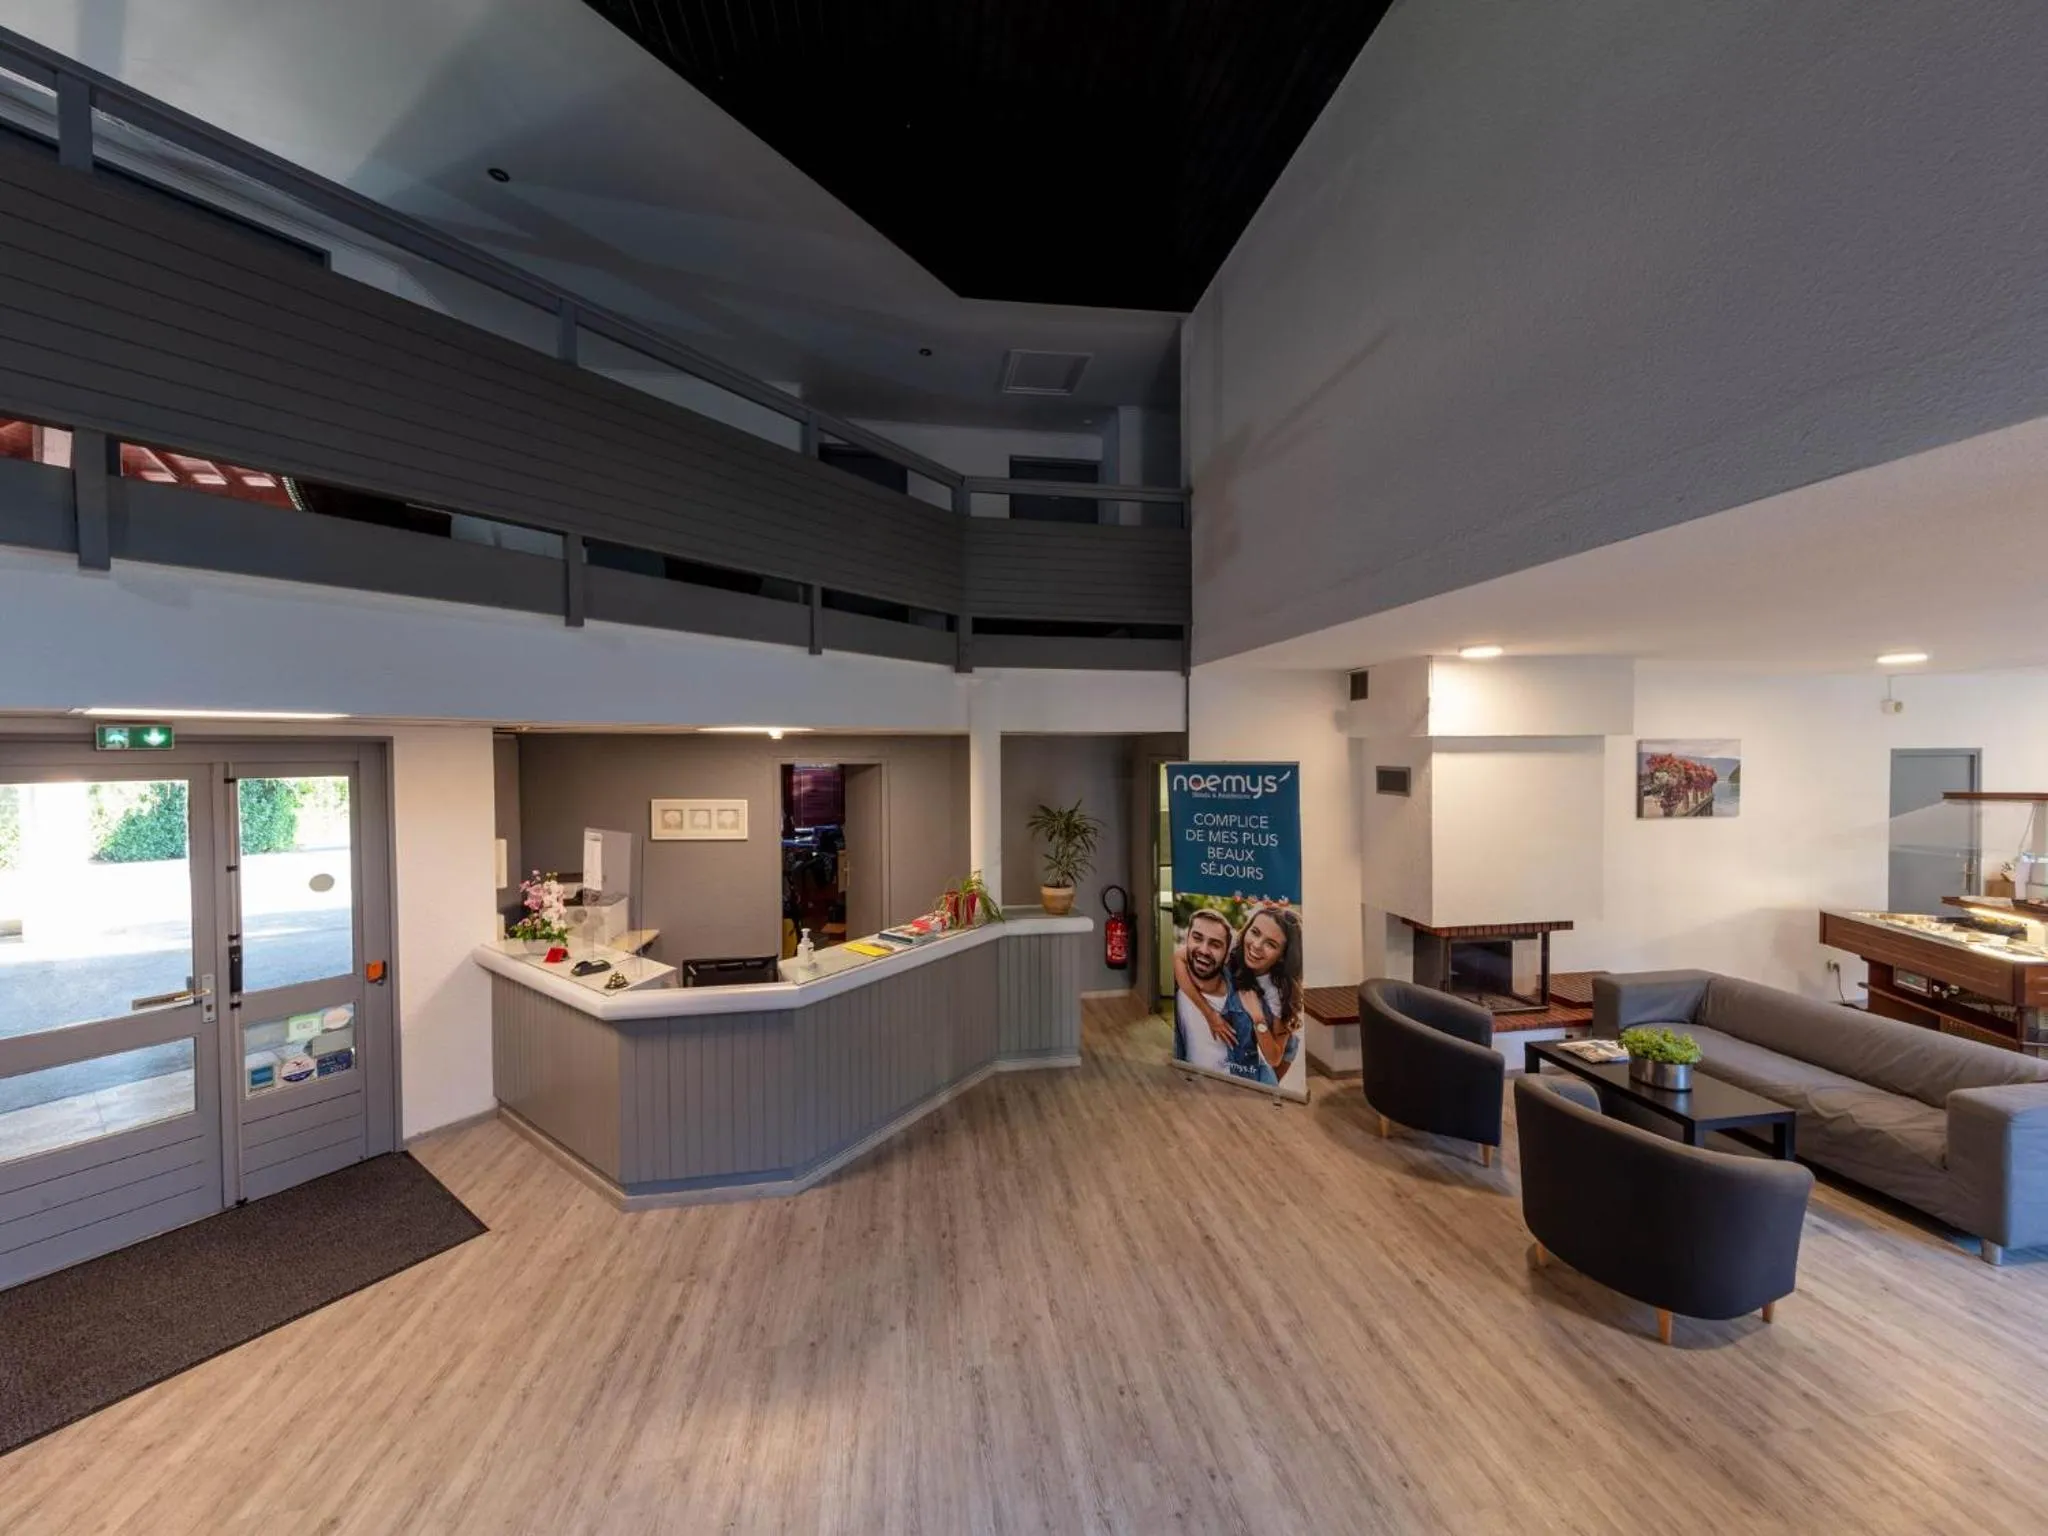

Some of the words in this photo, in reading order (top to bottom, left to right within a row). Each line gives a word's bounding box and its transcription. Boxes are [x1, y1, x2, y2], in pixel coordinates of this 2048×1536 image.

[1193, 813, 1269, 829] COMPLICE
[1186, 829, 1205, 842] DE
[1208, 831, 1238, 844] MES
[1242, 832, 1279, 847] PLUS
[1207, 847, 1255, 861] BEAUX
[1200, 862, 1264, 880] SÉJOURS
